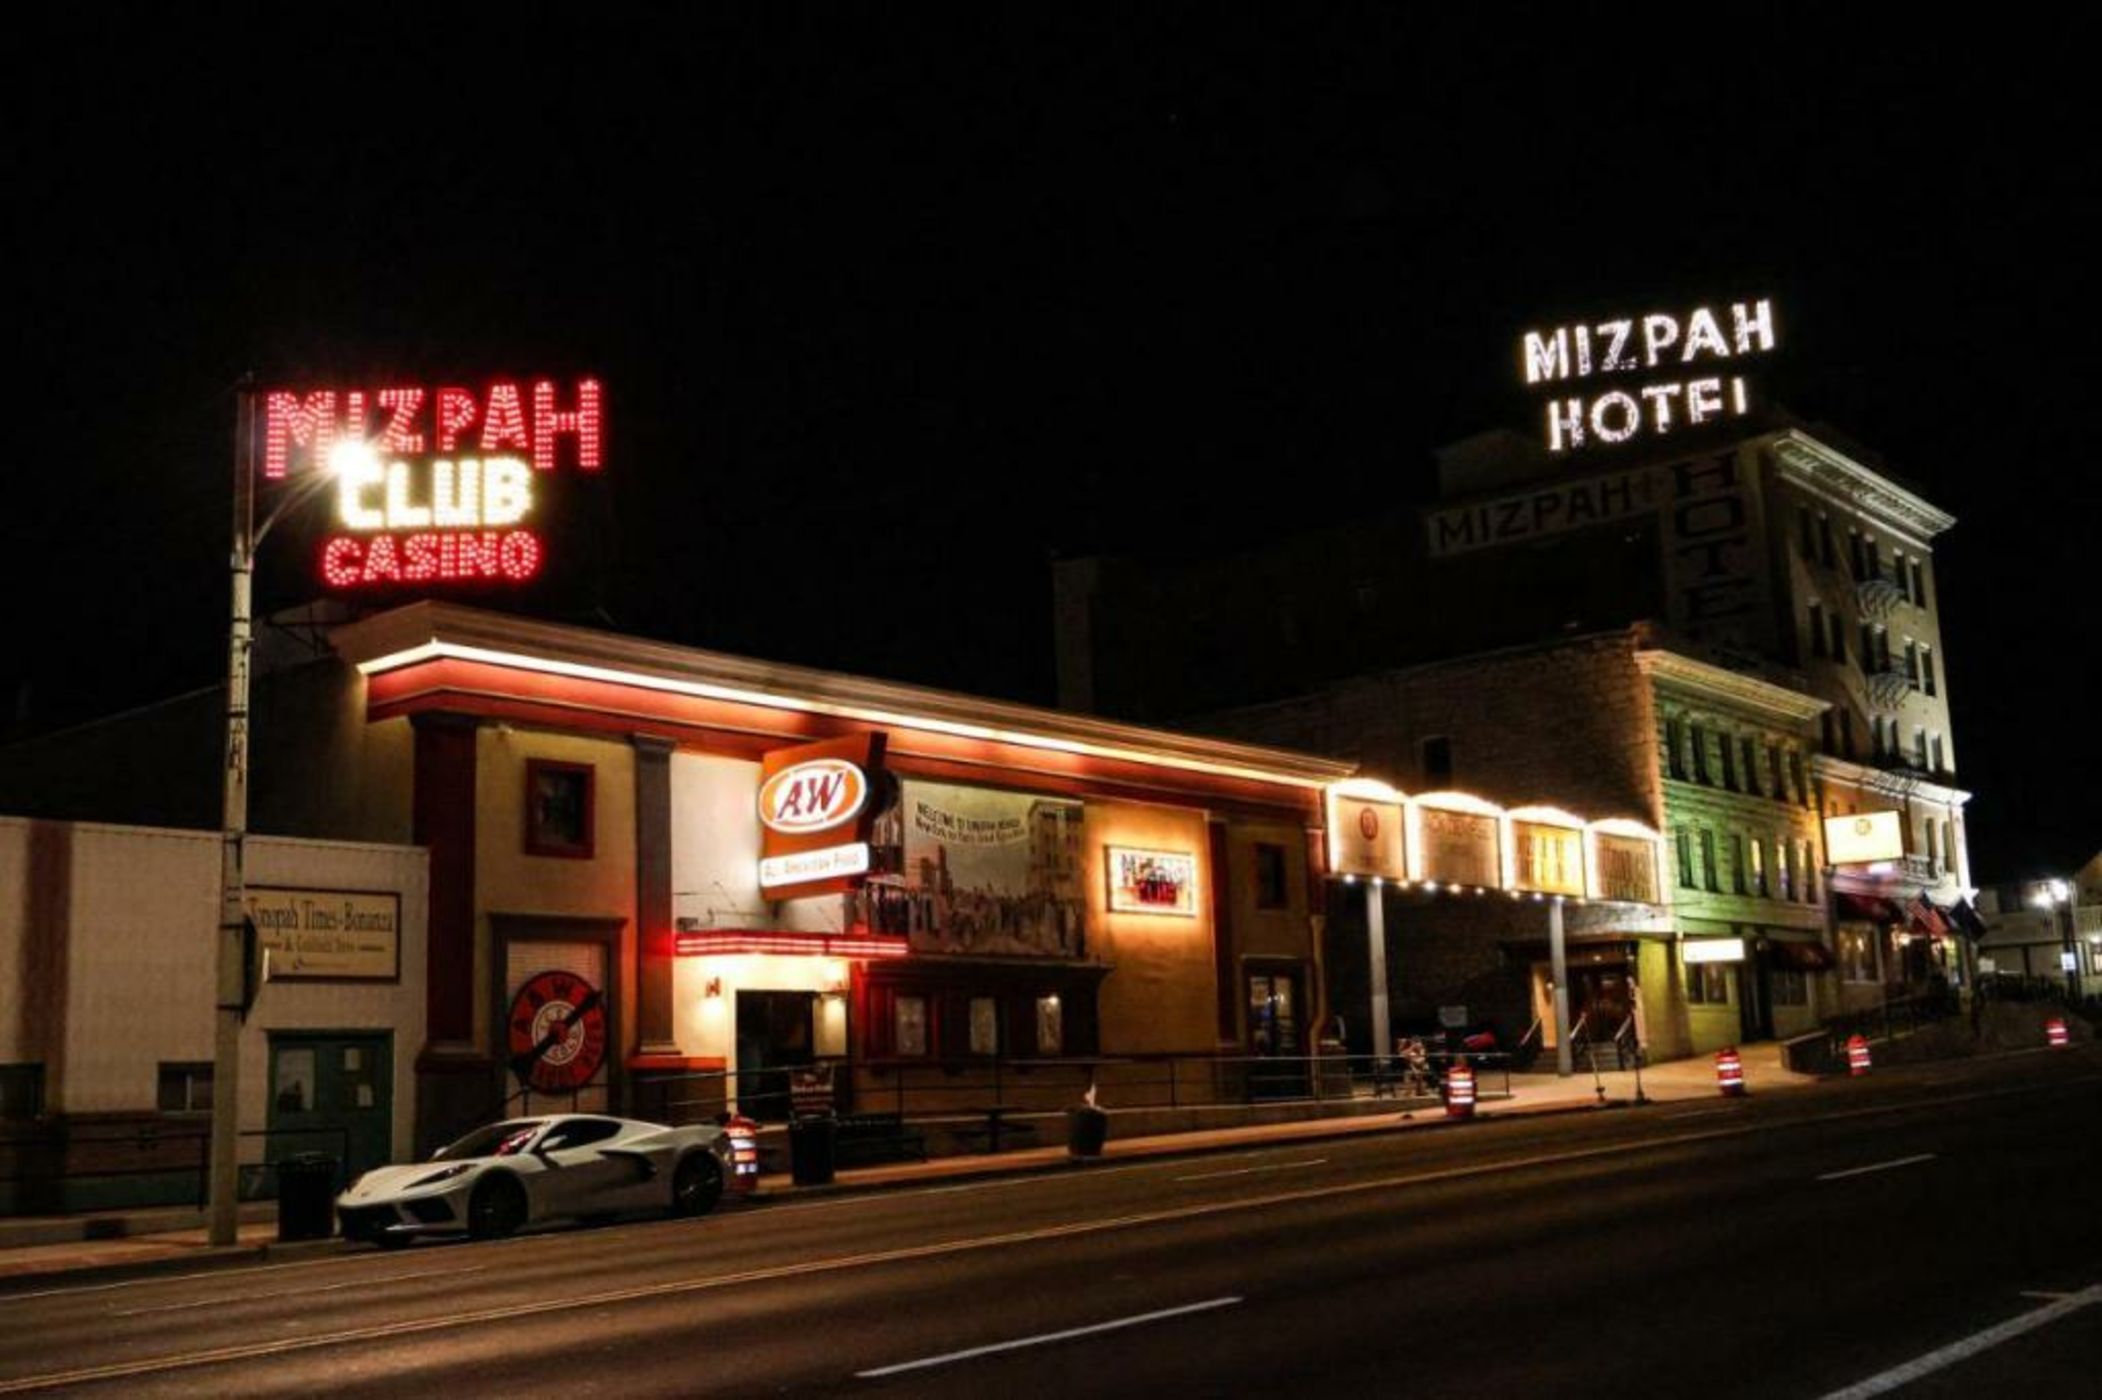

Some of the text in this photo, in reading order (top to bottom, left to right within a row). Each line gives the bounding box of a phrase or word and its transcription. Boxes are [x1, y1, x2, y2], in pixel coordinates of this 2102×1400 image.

[1522, 299, 1776, 384] MIZPAH
[266, 379, 600, 478] MIZPAH
[337, 453, 534, 530] CLUB
[1437, 475, 1631, 549] MIZPAH
[323, 530, 540, 586] CASINO
